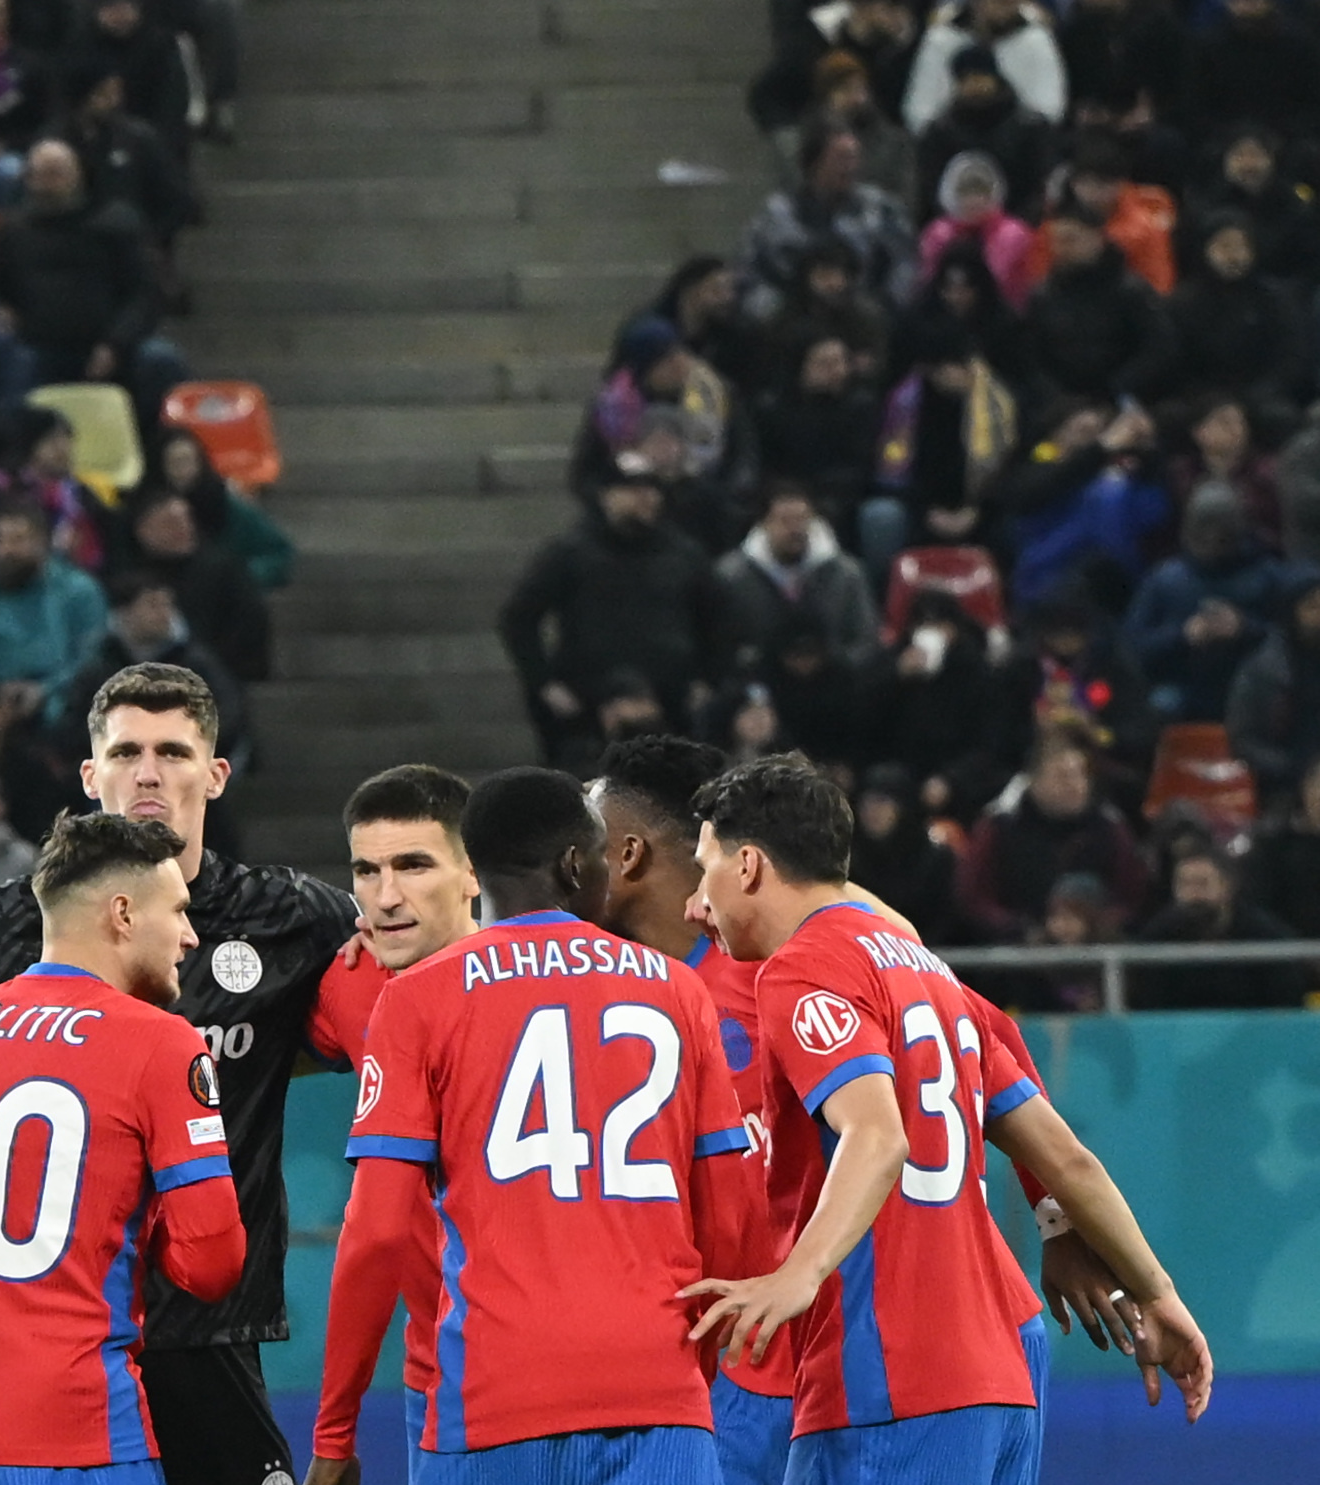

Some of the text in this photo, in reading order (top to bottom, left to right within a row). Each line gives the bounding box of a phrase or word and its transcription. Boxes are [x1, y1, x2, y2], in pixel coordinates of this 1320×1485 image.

[464, 936, 669, 992] ALHASSAN
[855, 930, 963, 991] RADUN
[796, 994, 856, 1049] MG
[485, 1002, 683, 1202] 42
